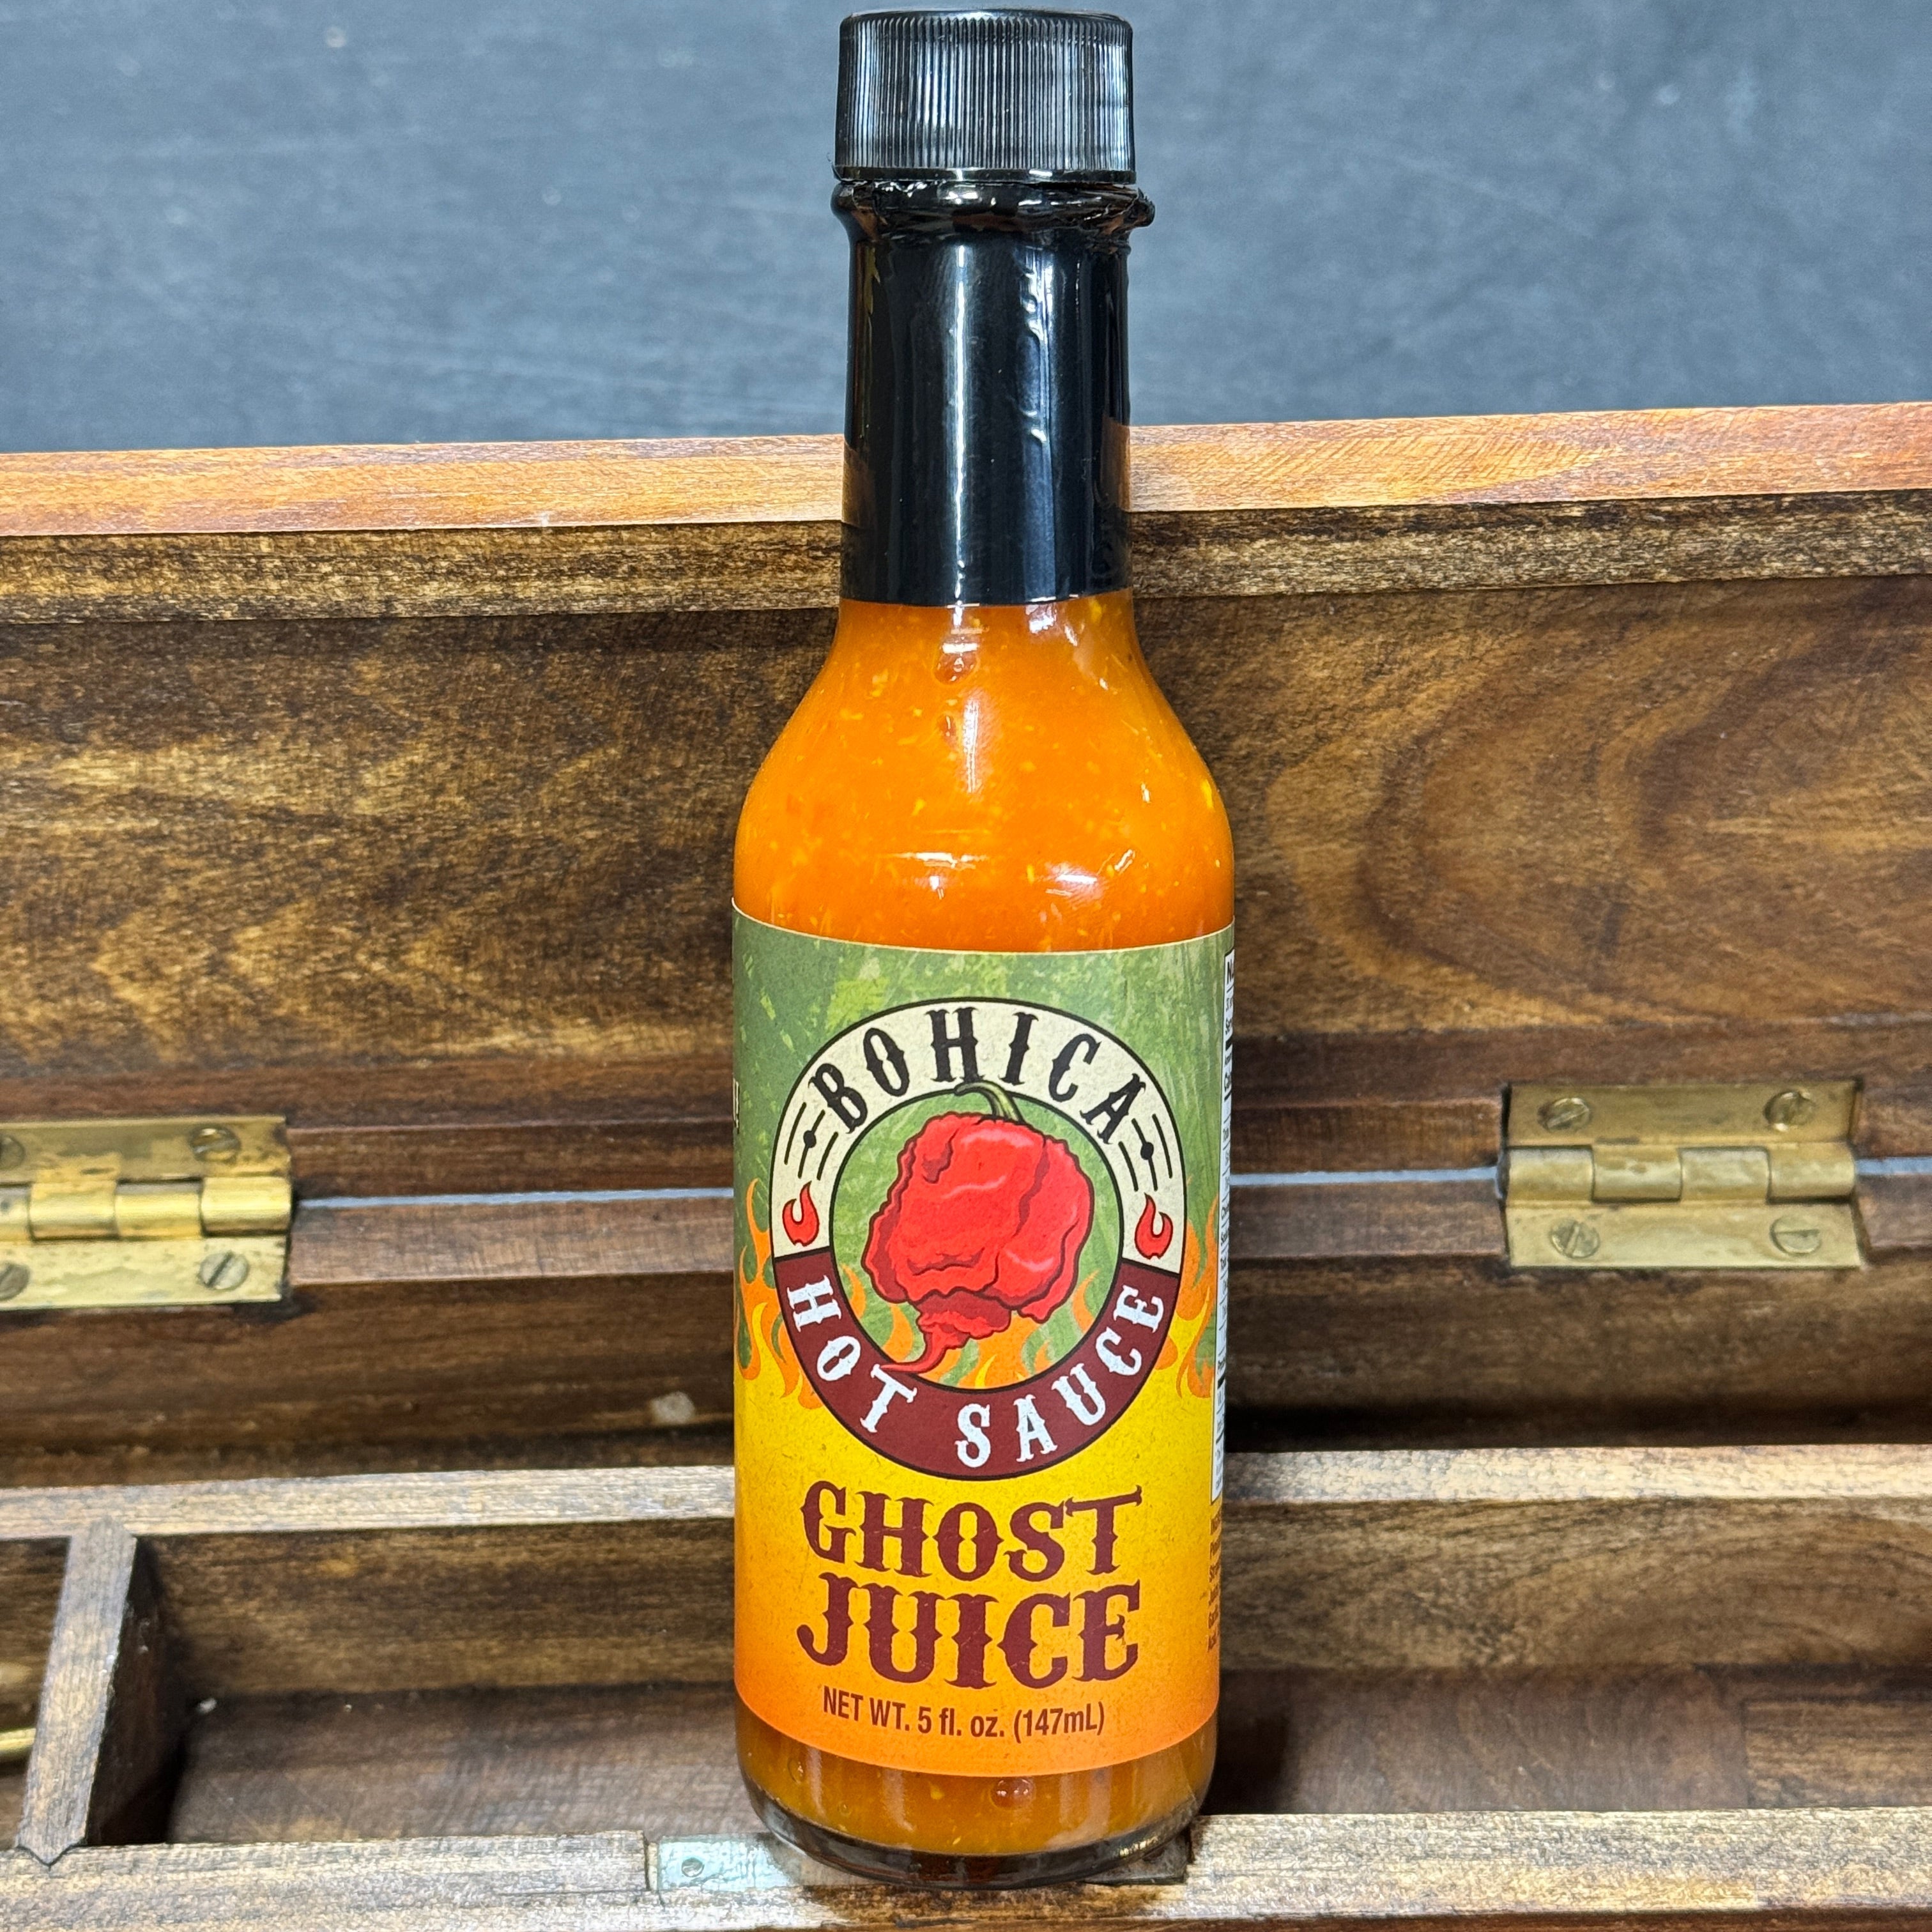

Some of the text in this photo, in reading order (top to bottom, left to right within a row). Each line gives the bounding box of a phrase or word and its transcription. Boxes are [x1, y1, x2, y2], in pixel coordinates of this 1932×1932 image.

[808, 1007, 1146, 1146] BOHICA
[786, 1275, 917, 1433] HOT
[954, 1284, 1165, 1468] SAUCE
[800, 1480, 1142, 1582] GHOST
[796, 1572, 1141, 1690] JUICE
[823, 1685, 1105, 1744] NET WT. 5 fl. oz. (147mL)
